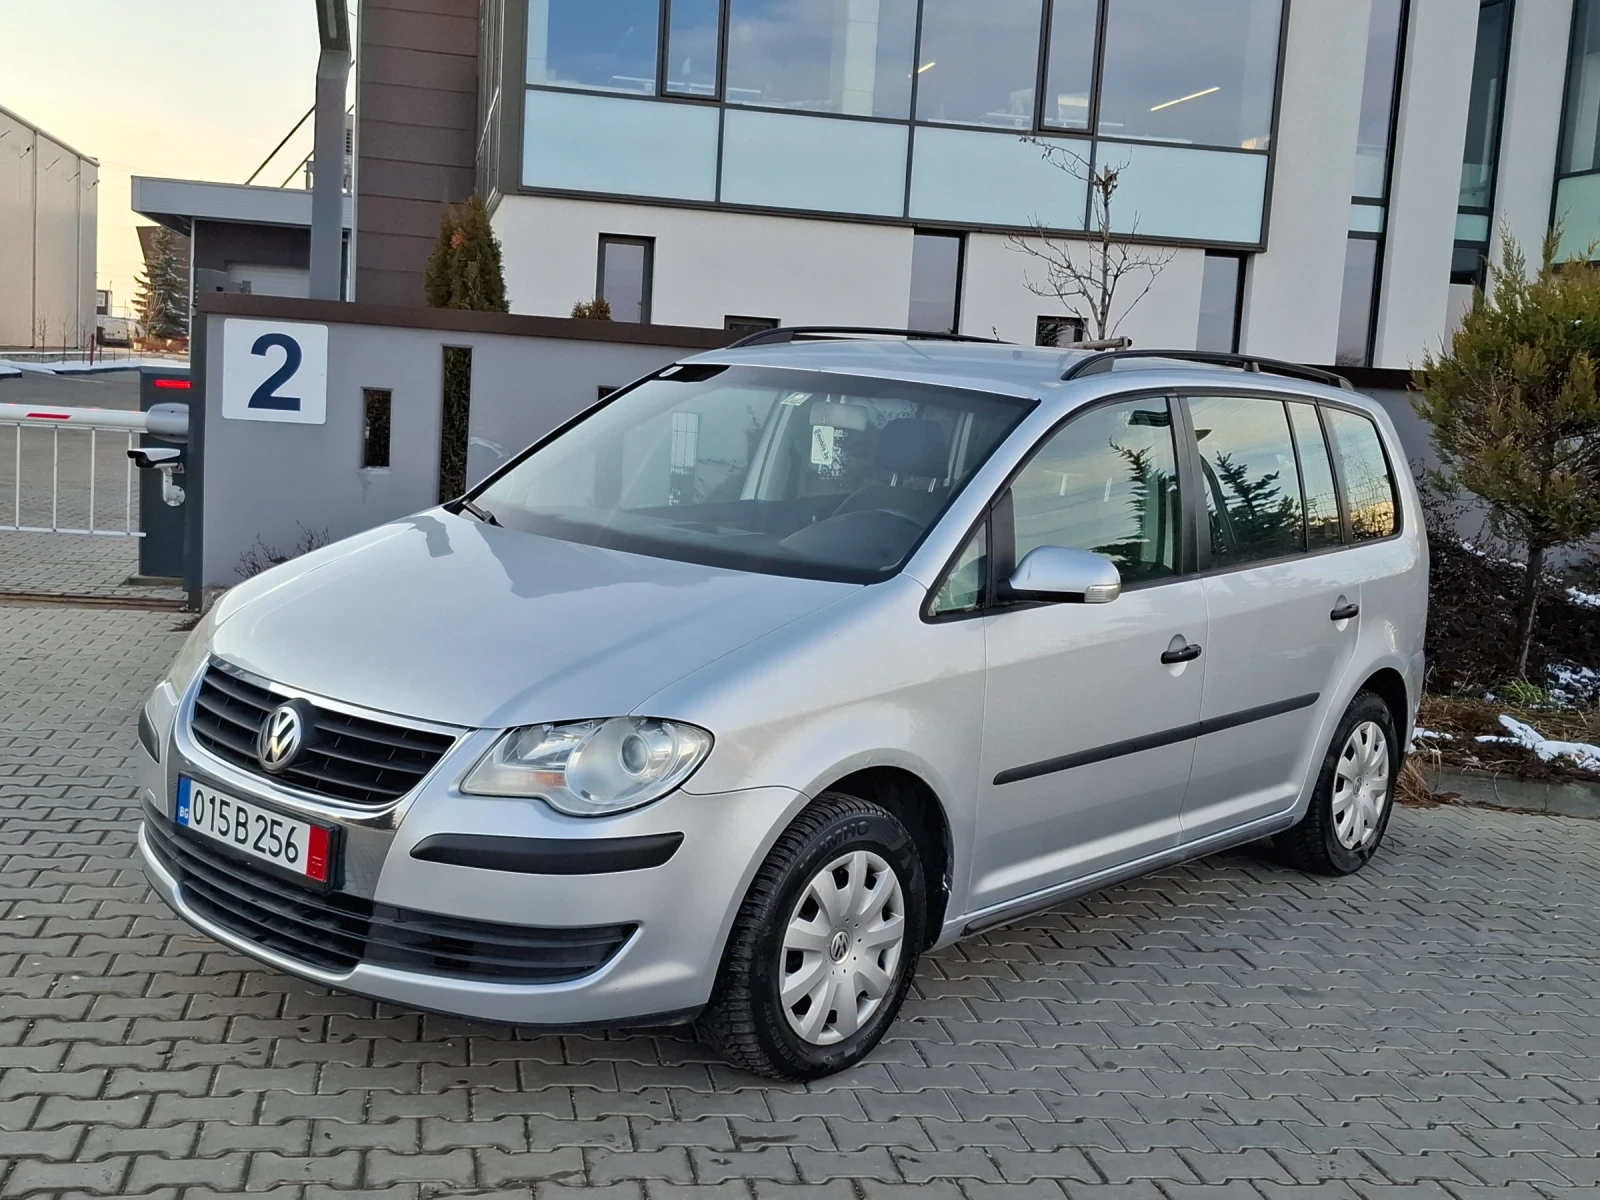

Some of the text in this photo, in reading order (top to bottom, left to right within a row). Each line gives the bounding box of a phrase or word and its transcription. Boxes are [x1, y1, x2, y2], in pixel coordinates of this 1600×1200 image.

[247, 332, 303, 412] 2
[257, 706, 301, 770] VW
[179, 806, 189, 818] BG
[800, 821, 869, 868] UMHO
